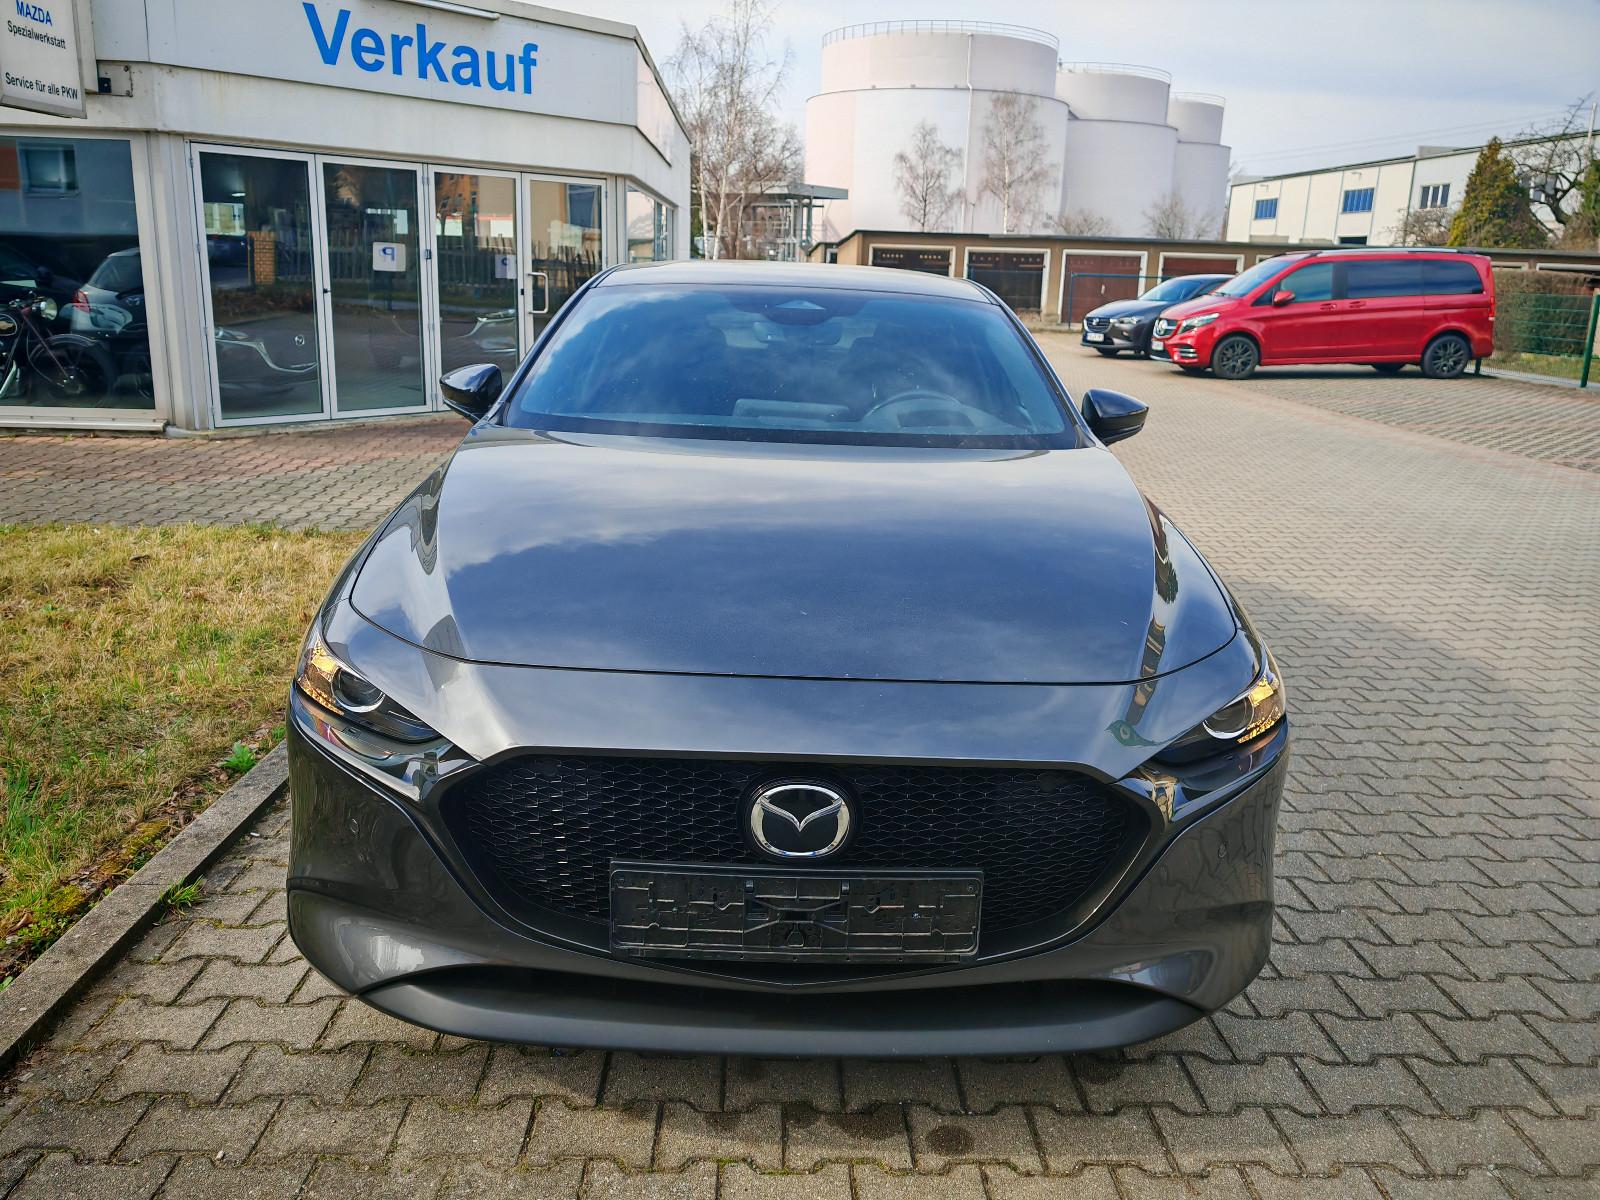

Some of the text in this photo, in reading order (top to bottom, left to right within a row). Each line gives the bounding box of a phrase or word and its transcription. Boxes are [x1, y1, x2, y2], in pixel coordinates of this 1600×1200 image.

[16, 0, 53, 26] MAZDA
[7, 20, 66, 49] Spezialwerkstatt
[303, 2, 539, 95] Verkauf
[5, 71, 78, 100] Service für alle PKW
